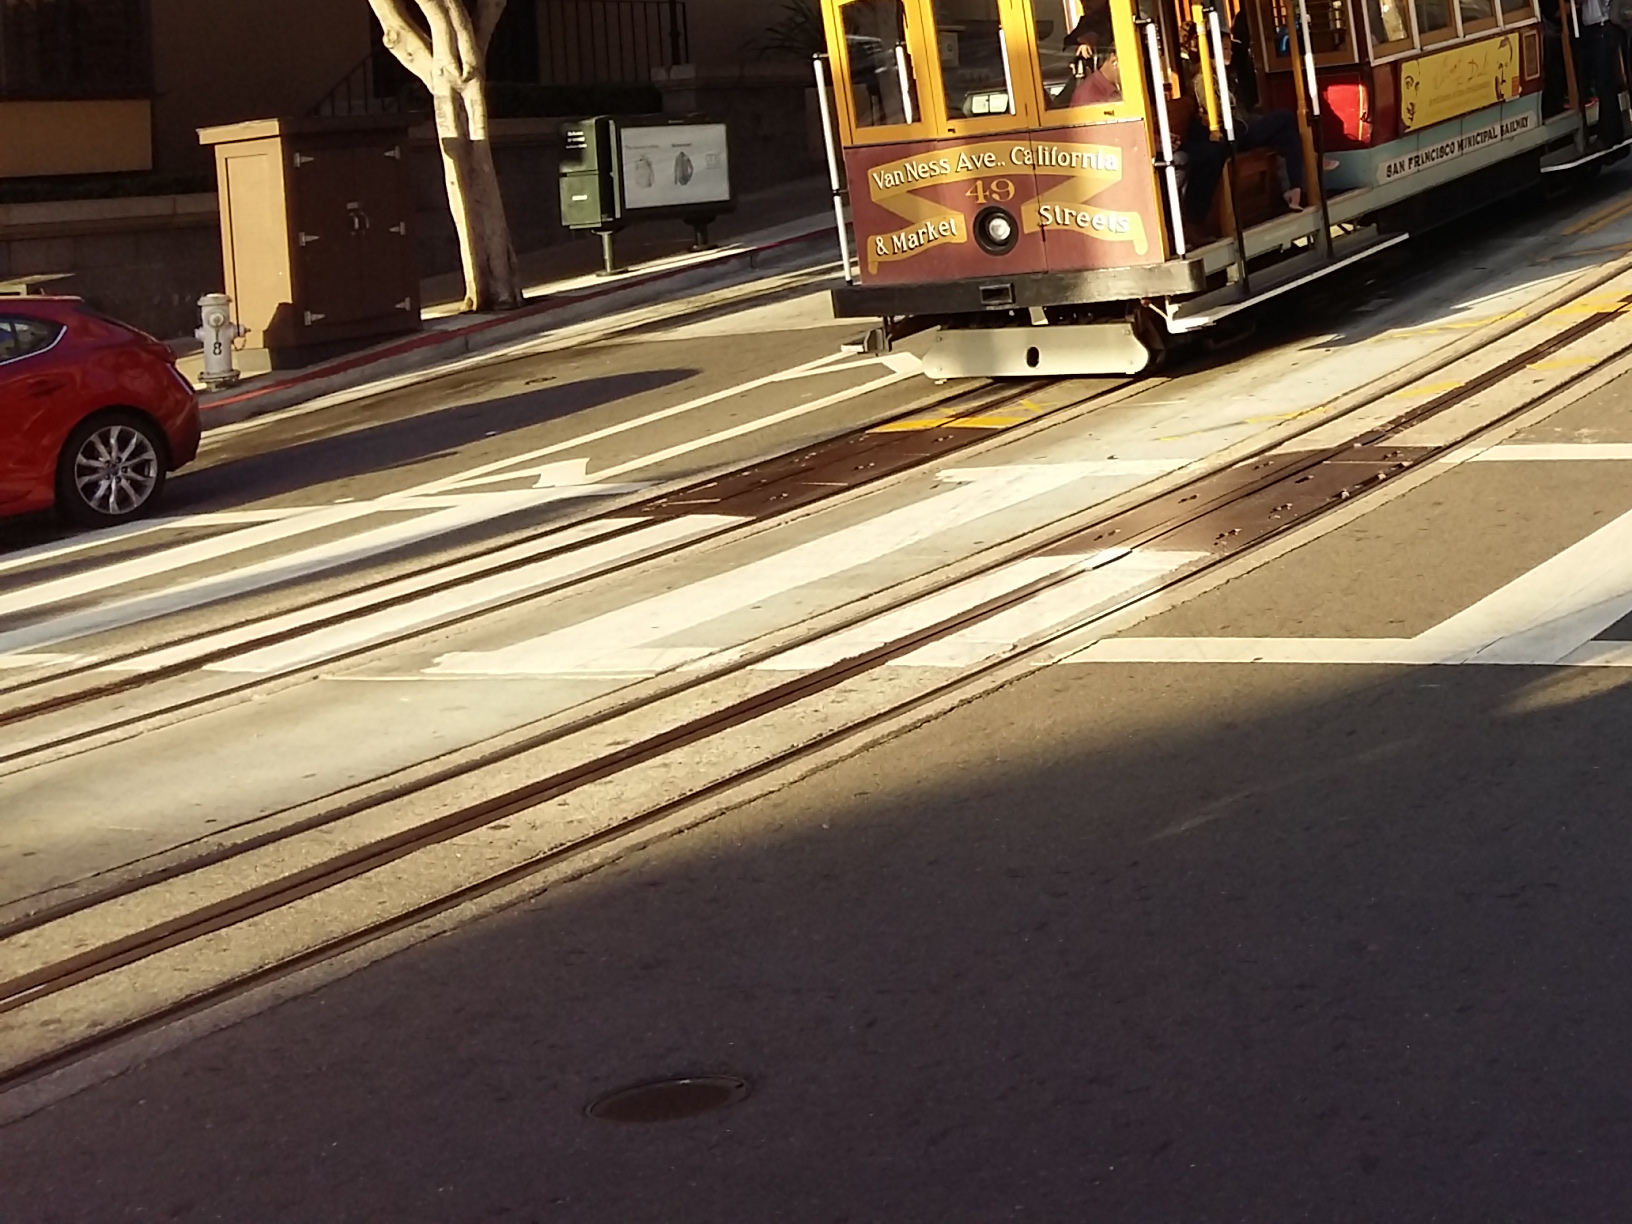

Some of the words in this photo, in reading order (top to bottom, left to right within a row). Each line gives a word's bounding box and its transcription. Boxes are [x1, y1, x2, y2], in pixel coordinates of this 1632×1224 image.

[1010, 145, 1119, 172] California
[1386, 161, 1406, 178] SAN
[1408, 140, 1456, 170] FRANCISCO
[1457, 127, 1498, 152] MUNICIPAL
[965, 178, 1016, 204] 49
[1038, 204, 1131, 235] Streets
[875, 235, 889, 256] &
[891, 217, 958, 254] Market
[213, 342, 222, 355] 8
